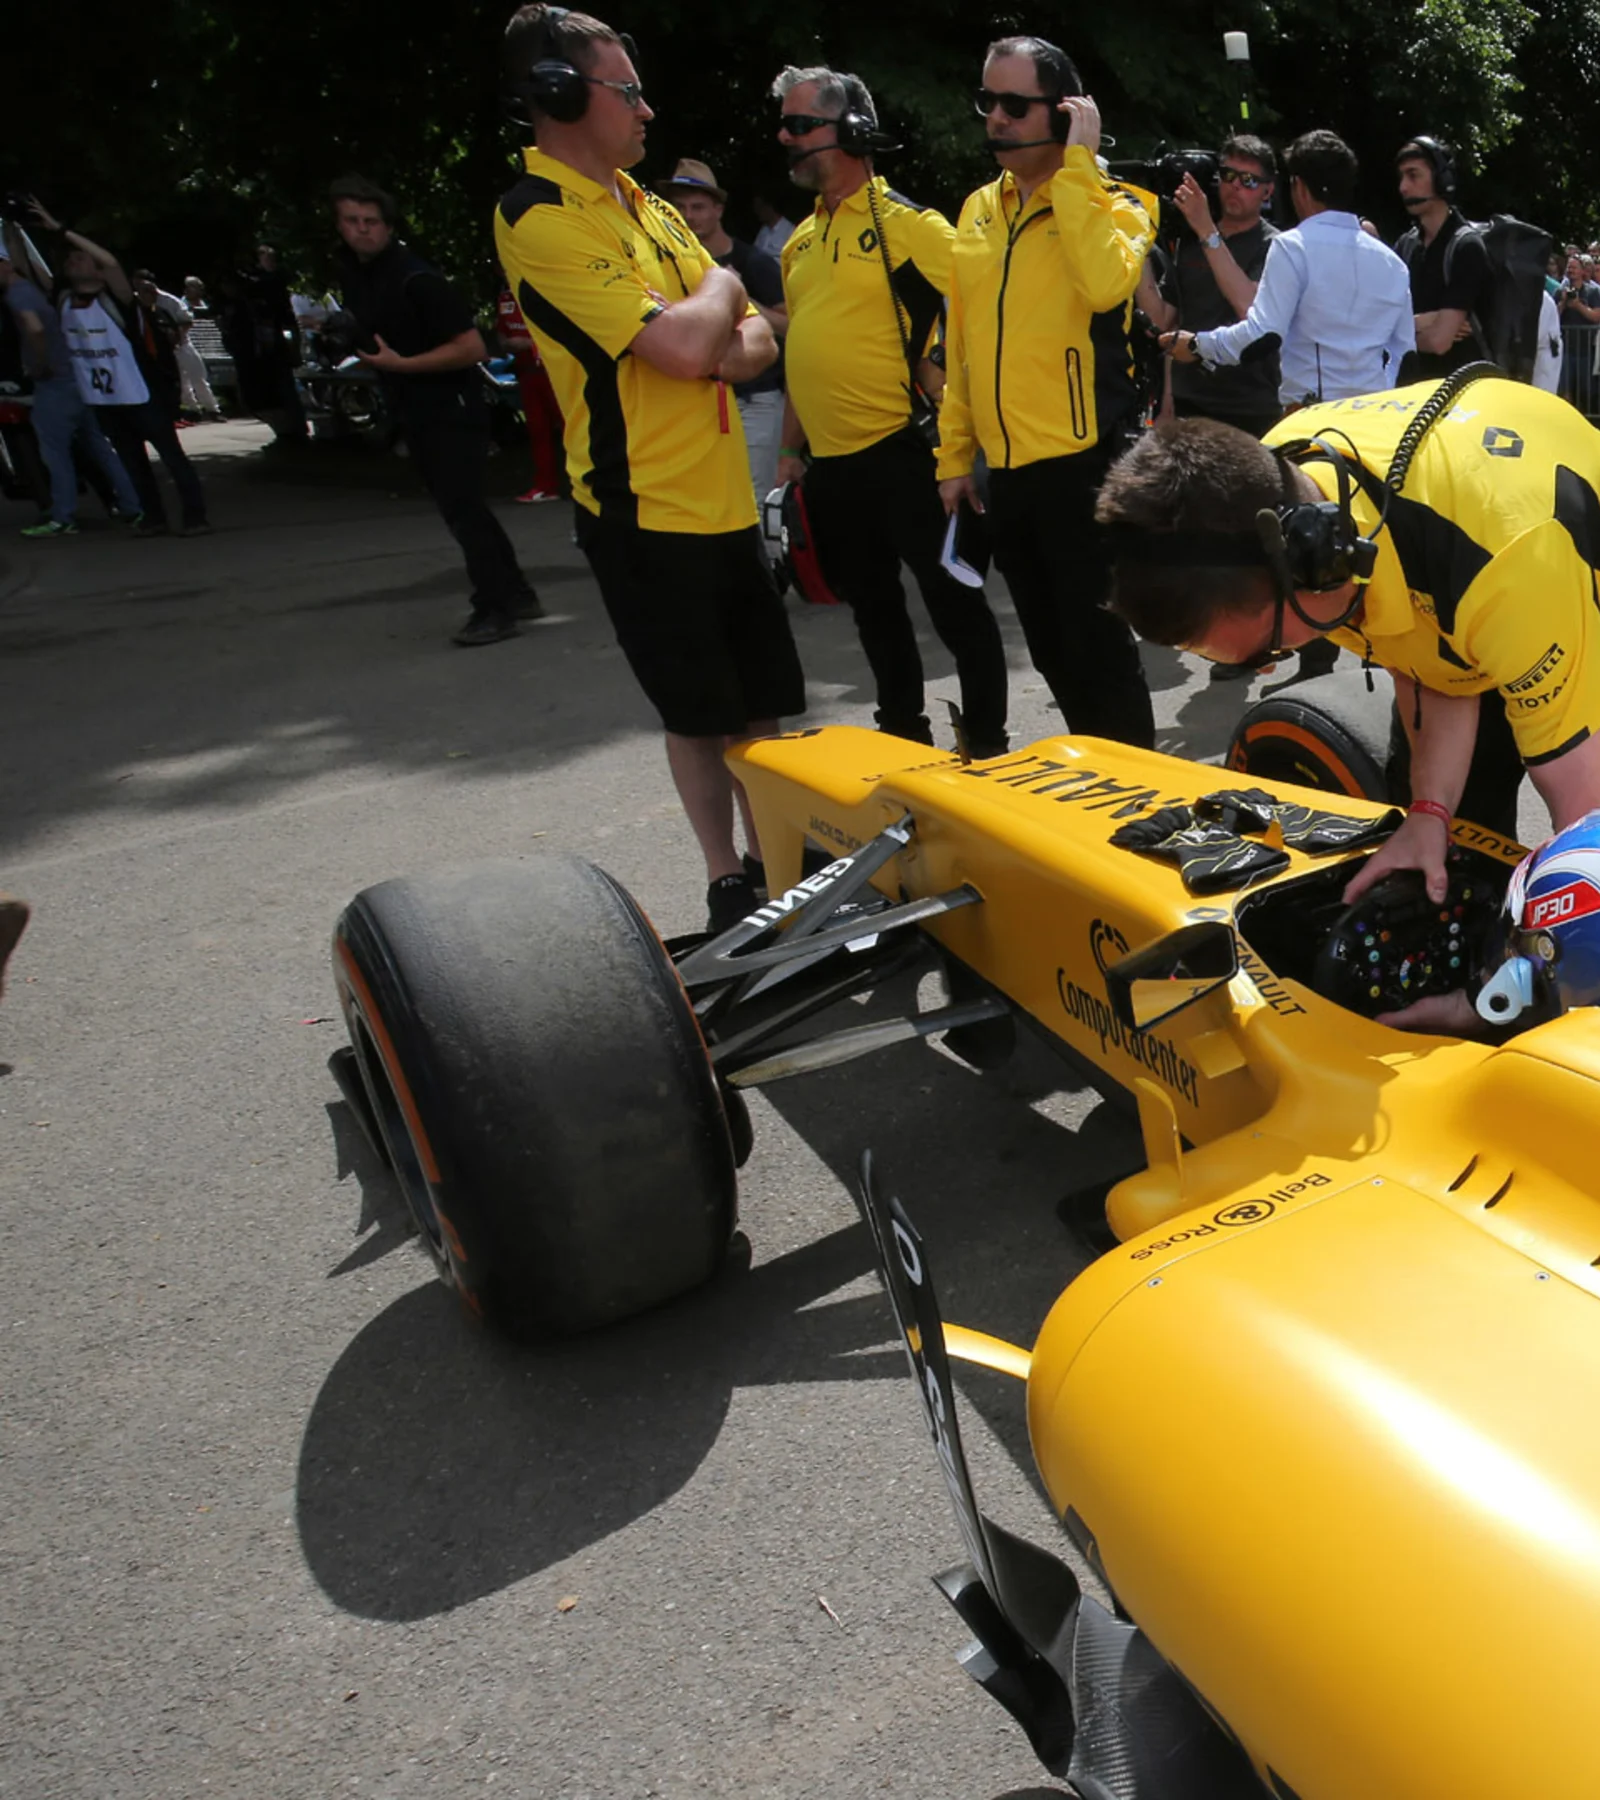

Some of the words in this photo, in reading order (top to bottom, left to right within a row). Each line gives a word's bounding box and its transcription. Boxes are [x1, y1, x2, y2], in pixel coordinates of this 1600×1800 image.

[91, 366, 115, 394] 42
[1504, 642, 1566, 694] PIRELLI
[1532, 893, 1575, 926] JP30
[1233, 940, 1308, 1017] ENAULT
[1268, 1172, 1333, 1203] Bell
[1129, 1223, 1218, 1261] Ross
